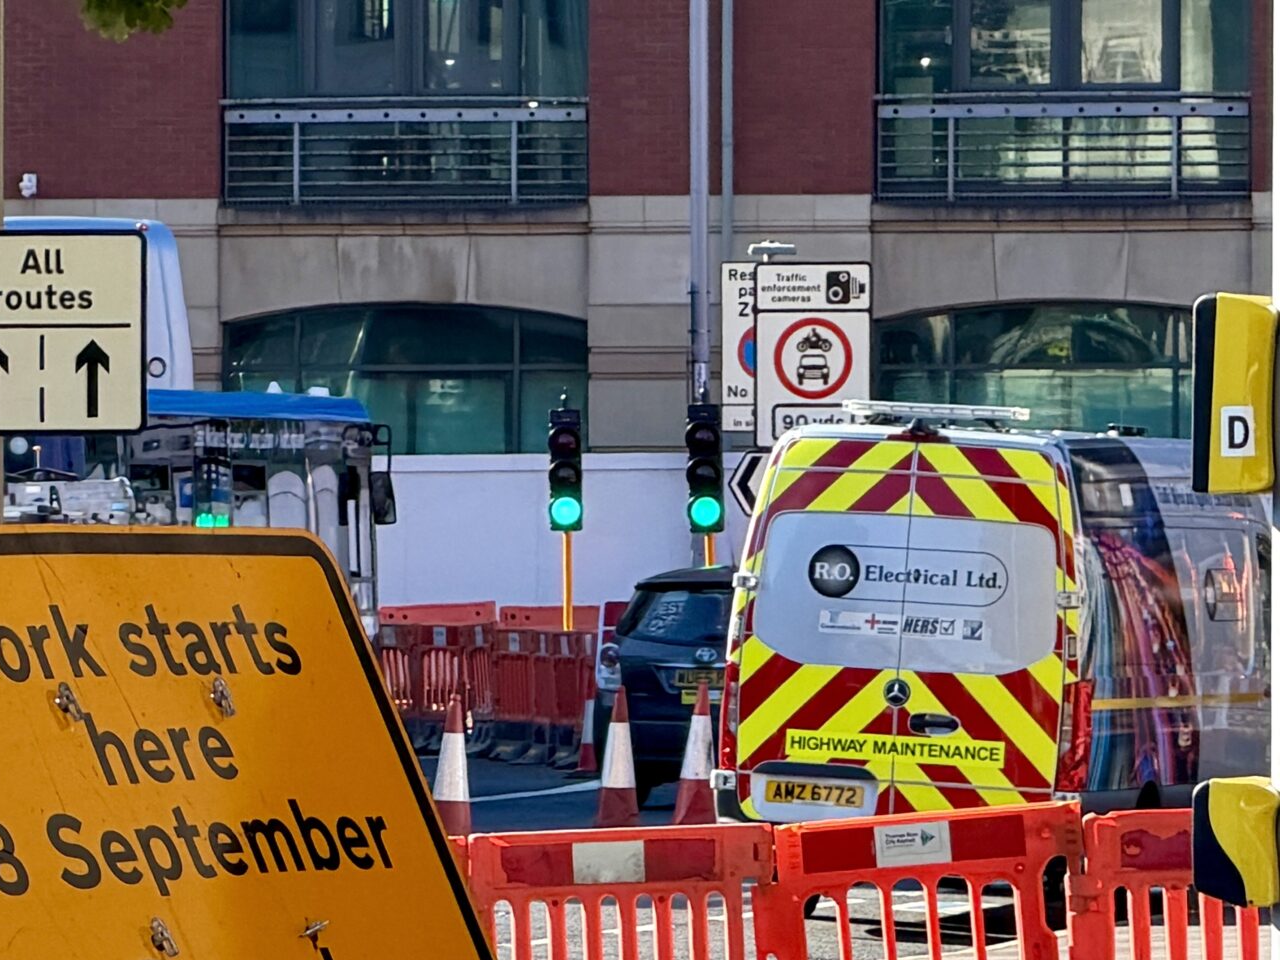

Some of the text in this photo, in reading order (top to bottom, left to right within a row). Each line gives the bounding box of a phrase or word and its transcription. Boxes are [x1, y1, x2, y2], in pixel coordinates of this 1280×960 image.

[21, 249, 64, 274] All
[761, 284, 821, 292] enforcement
[776, 273, 807, 282] Traffic
[771, 295, 811, 303] cameras
[727, 386, 748, 398] No
[1228, 415, 1250, 449] D
[813, 562, 854, 581] R.O.
[966, 571, 1003, 589] Ltd.
[118, 604, 302, 676] starts
[81, 712, 239, 786] here
[790, 735, 1001, 762] HIGHWAY MAINTENANCE
[773, 783, 857, 805] AMZ 6772
[46, 798, 393, 897] September
